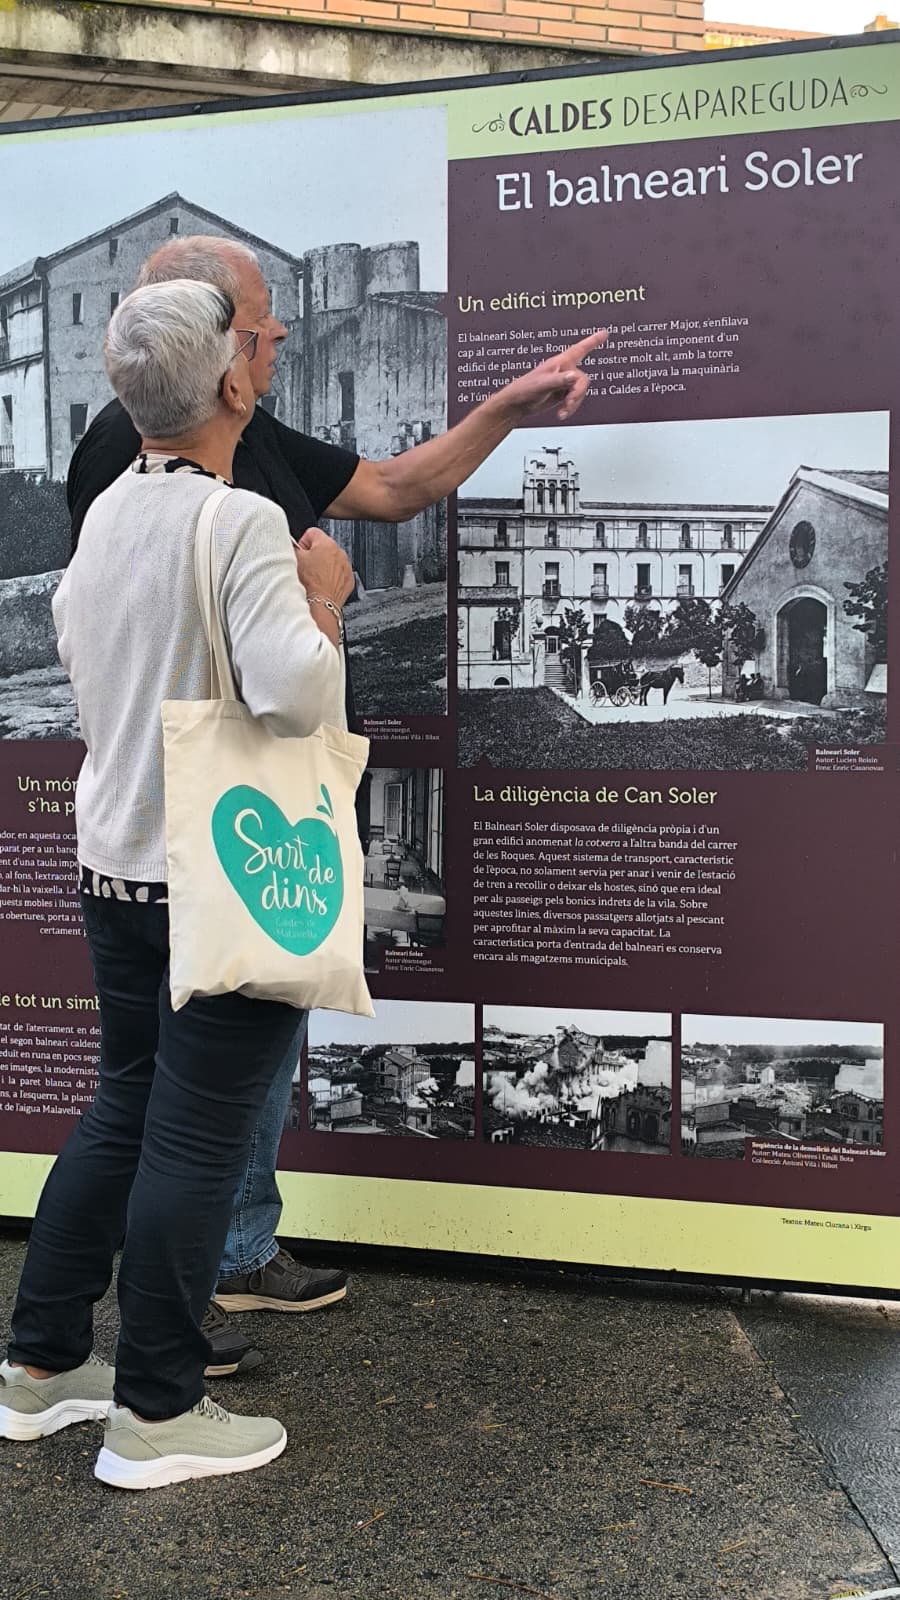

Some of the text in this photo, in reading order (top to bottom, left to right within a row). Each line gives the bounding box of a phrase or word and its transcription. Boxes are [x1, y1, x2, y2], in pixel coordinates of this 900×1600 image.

[509, 77, 849, 136] CALDES DESAPAREGUDA
[496, 148, 863, 211] El balneari Soler
[458, 285, 646, 312] Un edifici imponent
[469, 331, 508, 342] balneari
[509, 330, 535, 340] Soler,
[537, 328, 558, 338] amb
[620, 323, 635, 336] pel
[637, 323, 668, 332] carrer
[670, 320, 701, 332] Major,
[702, 317, 749, 328] s'enfilava
[457, 332, 739, 359] cap carrer les presència imponent d'un
[457, 349, 733, 373] edifici planta sostre molt amb torre
[457, 364, 740, 388] central que que allotjava maquinària
[609, 382, 686, 394] Caldes l'època.
[18, 776, 40, 791] Un
[474, 786, 717, 806] La diligència de Can Soler
[28, 798, 60, 812] s'ha
[29, 830, 61, 842] aquesta
[484, 821, 720, 836] Balneari Soler disposava diligència pròpia d'un
[234, 808, 310, 874] Surt
[473, 836, 738, 850] gran edifici anomenat cotxera l'altra banda del carrer
[12, 856, 57, 867] d'una taula
[501, 850, 734, 866] Roques. Aquest sistema transport, característic
[308, 854, 336, 885] de
[534, 866, 576, 876] solament
[578, 867, 607, 877] servia
[627, 870, 650, 878] anar
[656, 869, 682, 878] venir
[698, 869, 736, 880] l'estació
[32, 884, 64, 894] vaixella.
[261, 871, 328, 916] dins
[486, 879, 721, 896] tren recollir deixar els hostes, sinó que era ideal
[24, 898, 82, 909] mobles llums
[505, 894, 708, 908] passeigs pels bonics indrets vila. Sobre
[48, 912, 69, 924] porta
[473, 908, 725, 926] aquestes diversos passatgers allotjats pescant
[40, 926, 81, 936] certament
[490, 923, 657, 938] aprofitar seva capacitat.
[473, 938, 722, 955] característica porta d'entrada balneari conserva
[505, 952, 518, 962] als
[520, 954, 572, 965] magatzems
[574, 955, 628, 968] municipals.
[15, 993, 62, 1009] tot un
[26, 1023, 75, 1034] l'aterrament
[10, 1037, 68, 1047] segon balneari
[32, 1052, 82, 1063] runa pocs
[53, 1065, 99, 1076] modernista
[20, 1076, 72, 1087] paret blanca
[16, 1102, 83, 1115] l'aigua Malavella.
